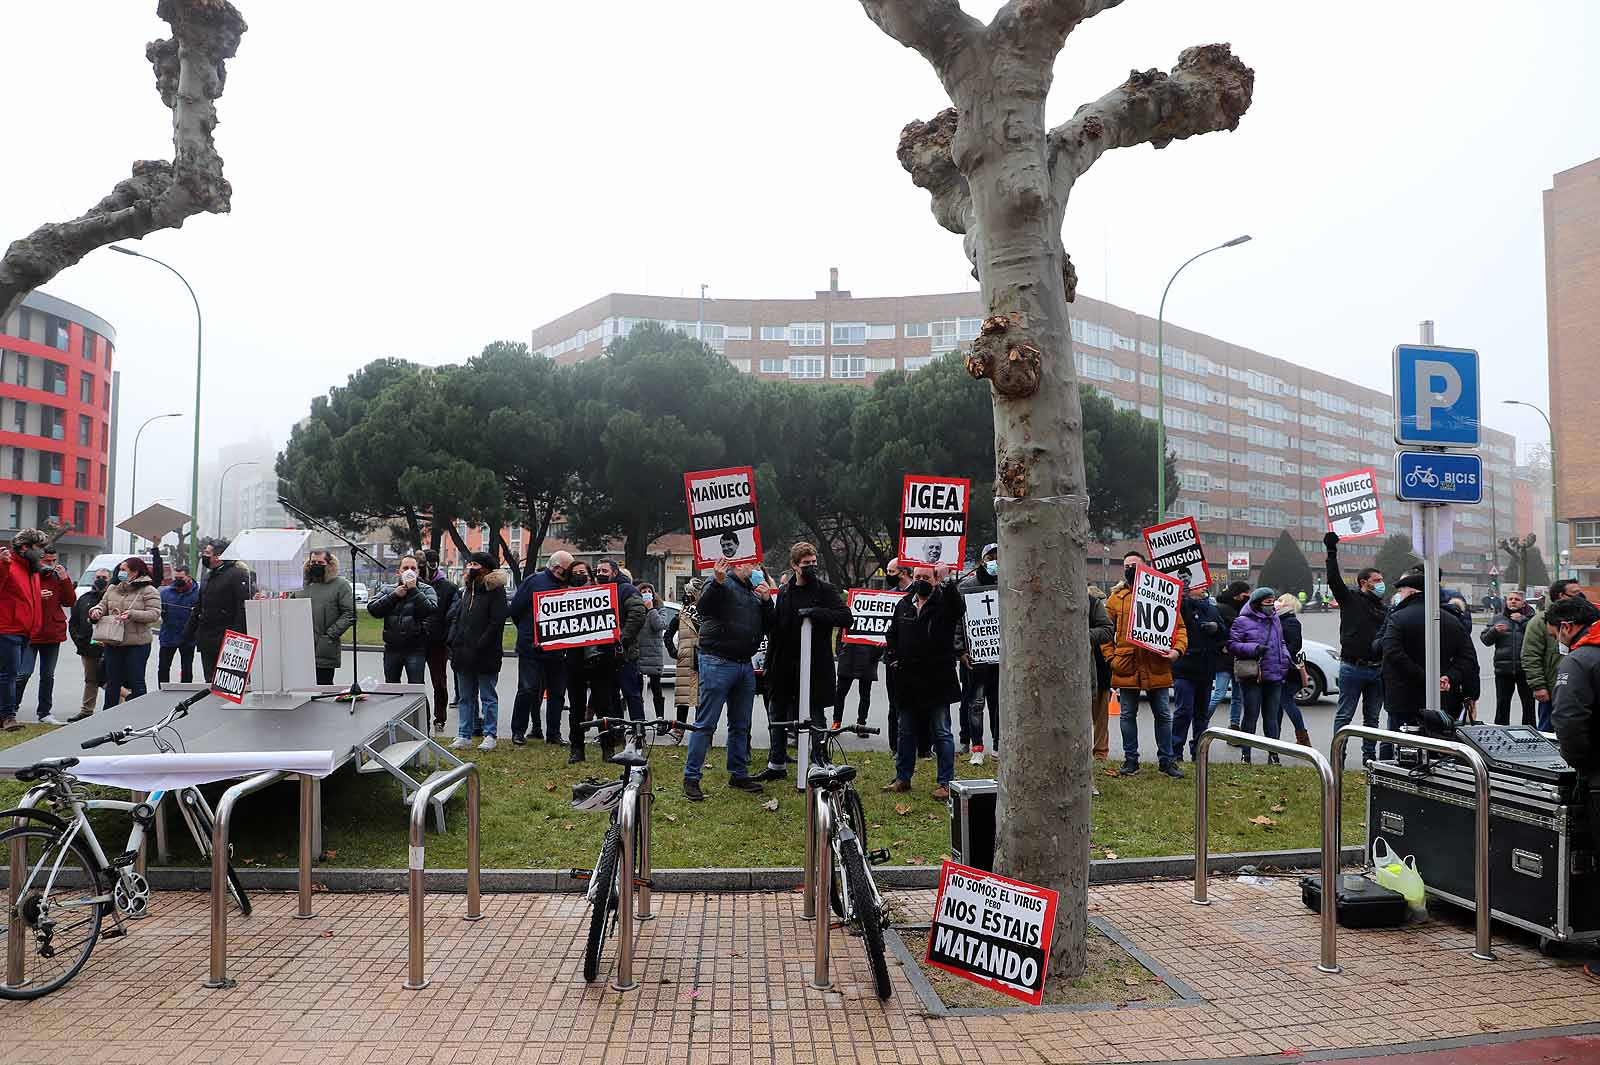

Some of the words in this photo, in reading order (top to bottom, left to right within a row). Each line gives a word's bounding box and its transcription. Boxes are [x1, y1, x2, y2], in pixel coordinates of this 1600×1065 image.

[1415, 360, 1462, 430] P
[1325, 478, 1373, 497] MAÑUECO
[1444, 472, 1476, 484] BICIS
[689, 481, 751, 502] MAÑUECO
[910, 484, 959, 511] IGEA
[1327, 498, 1376, 517] DIMISIÓN
[693, 509, 755, 530] DIMISIÓN
[904, 516, 963, 533] DIMISIÓN
[1149, 528, 1195, 550] MAÑUECO
[1155, 549, 1202, 570] DIMISIÓN
[1143, 573, 1155, 588] SI
[1158, 579, 1174, 596] NO
[541, 595, 610, 617] QUEREMOS
[1137, 586, 1175, 609] COBRAMOS
[539, 614, 616, 637] TRABAJAR
[1136, 601, 1169, 632] NO
[975, 639, 988, 647] NOS
[1132, 630, 1173, 647] PAGAMOS
[214, 668, 244, 694] MATANDO
[952, 875, 964, 888] NO
[966, 880, 997, 898] SOMOS
[1000, 889, 1010, 903] EL
[1014, 893, 1042, 912] VIRUS
[984, 898, 1001, 910] PERO
[944, 897, 977, 924] NOS
[981, 909, 1039, 946] ESTAIS
[934, 926, 1038, 986] MATANDO
